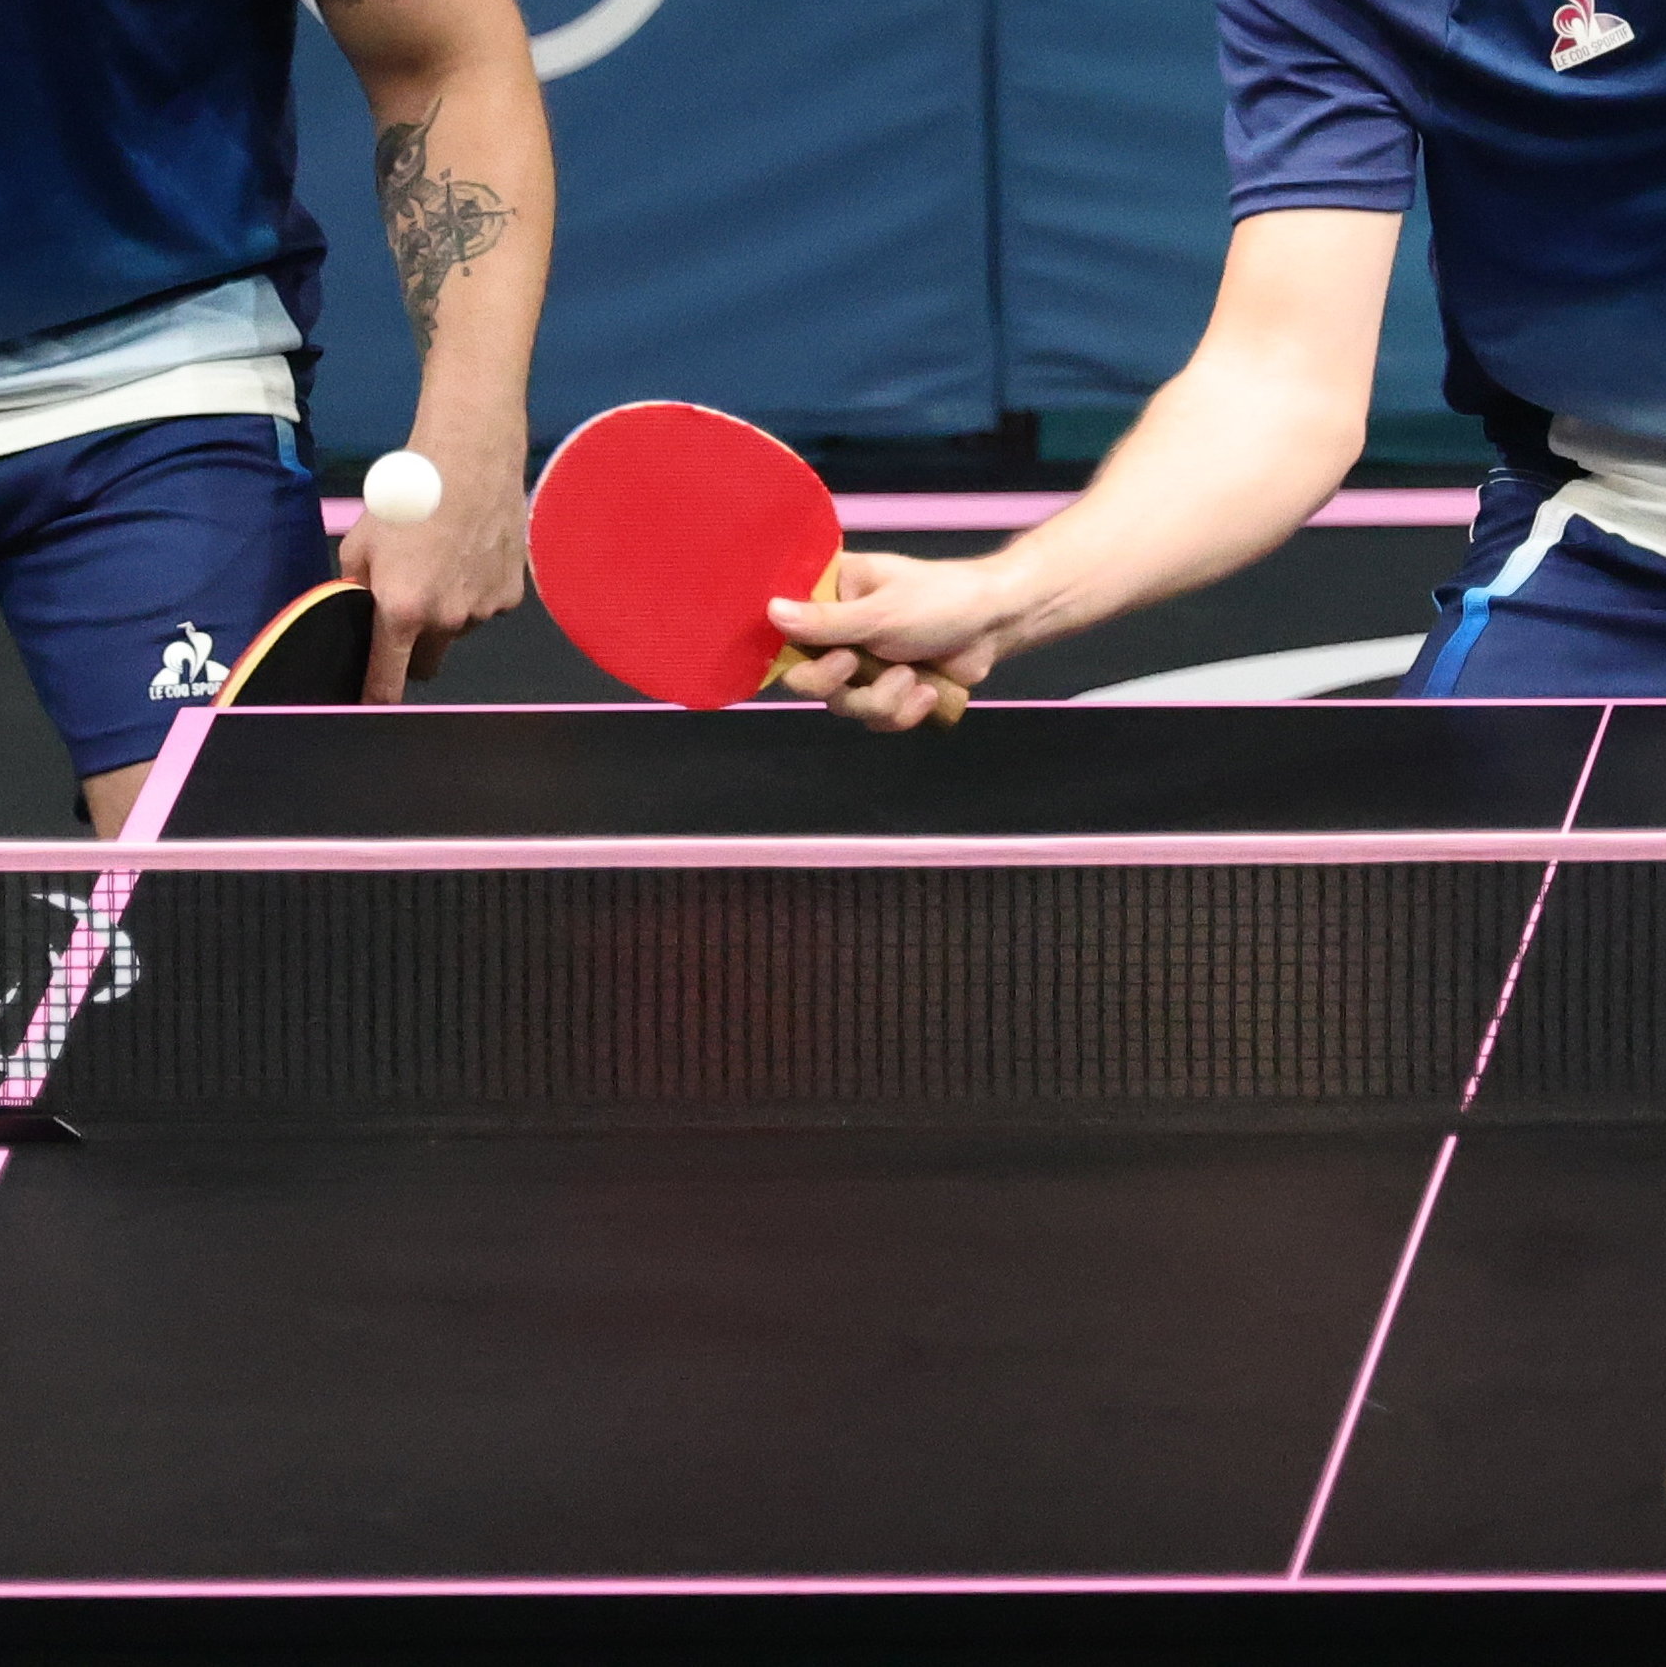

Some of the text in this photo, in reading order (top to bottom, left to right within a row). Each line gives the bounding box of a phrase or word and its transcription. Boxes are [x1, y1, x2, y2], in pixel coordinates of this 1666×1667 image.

[1555, 26, 1629, 68] LE COQ SPORTIF
[148, 685, 164, 702] LE
[164, 683, 191, 699] COQ
